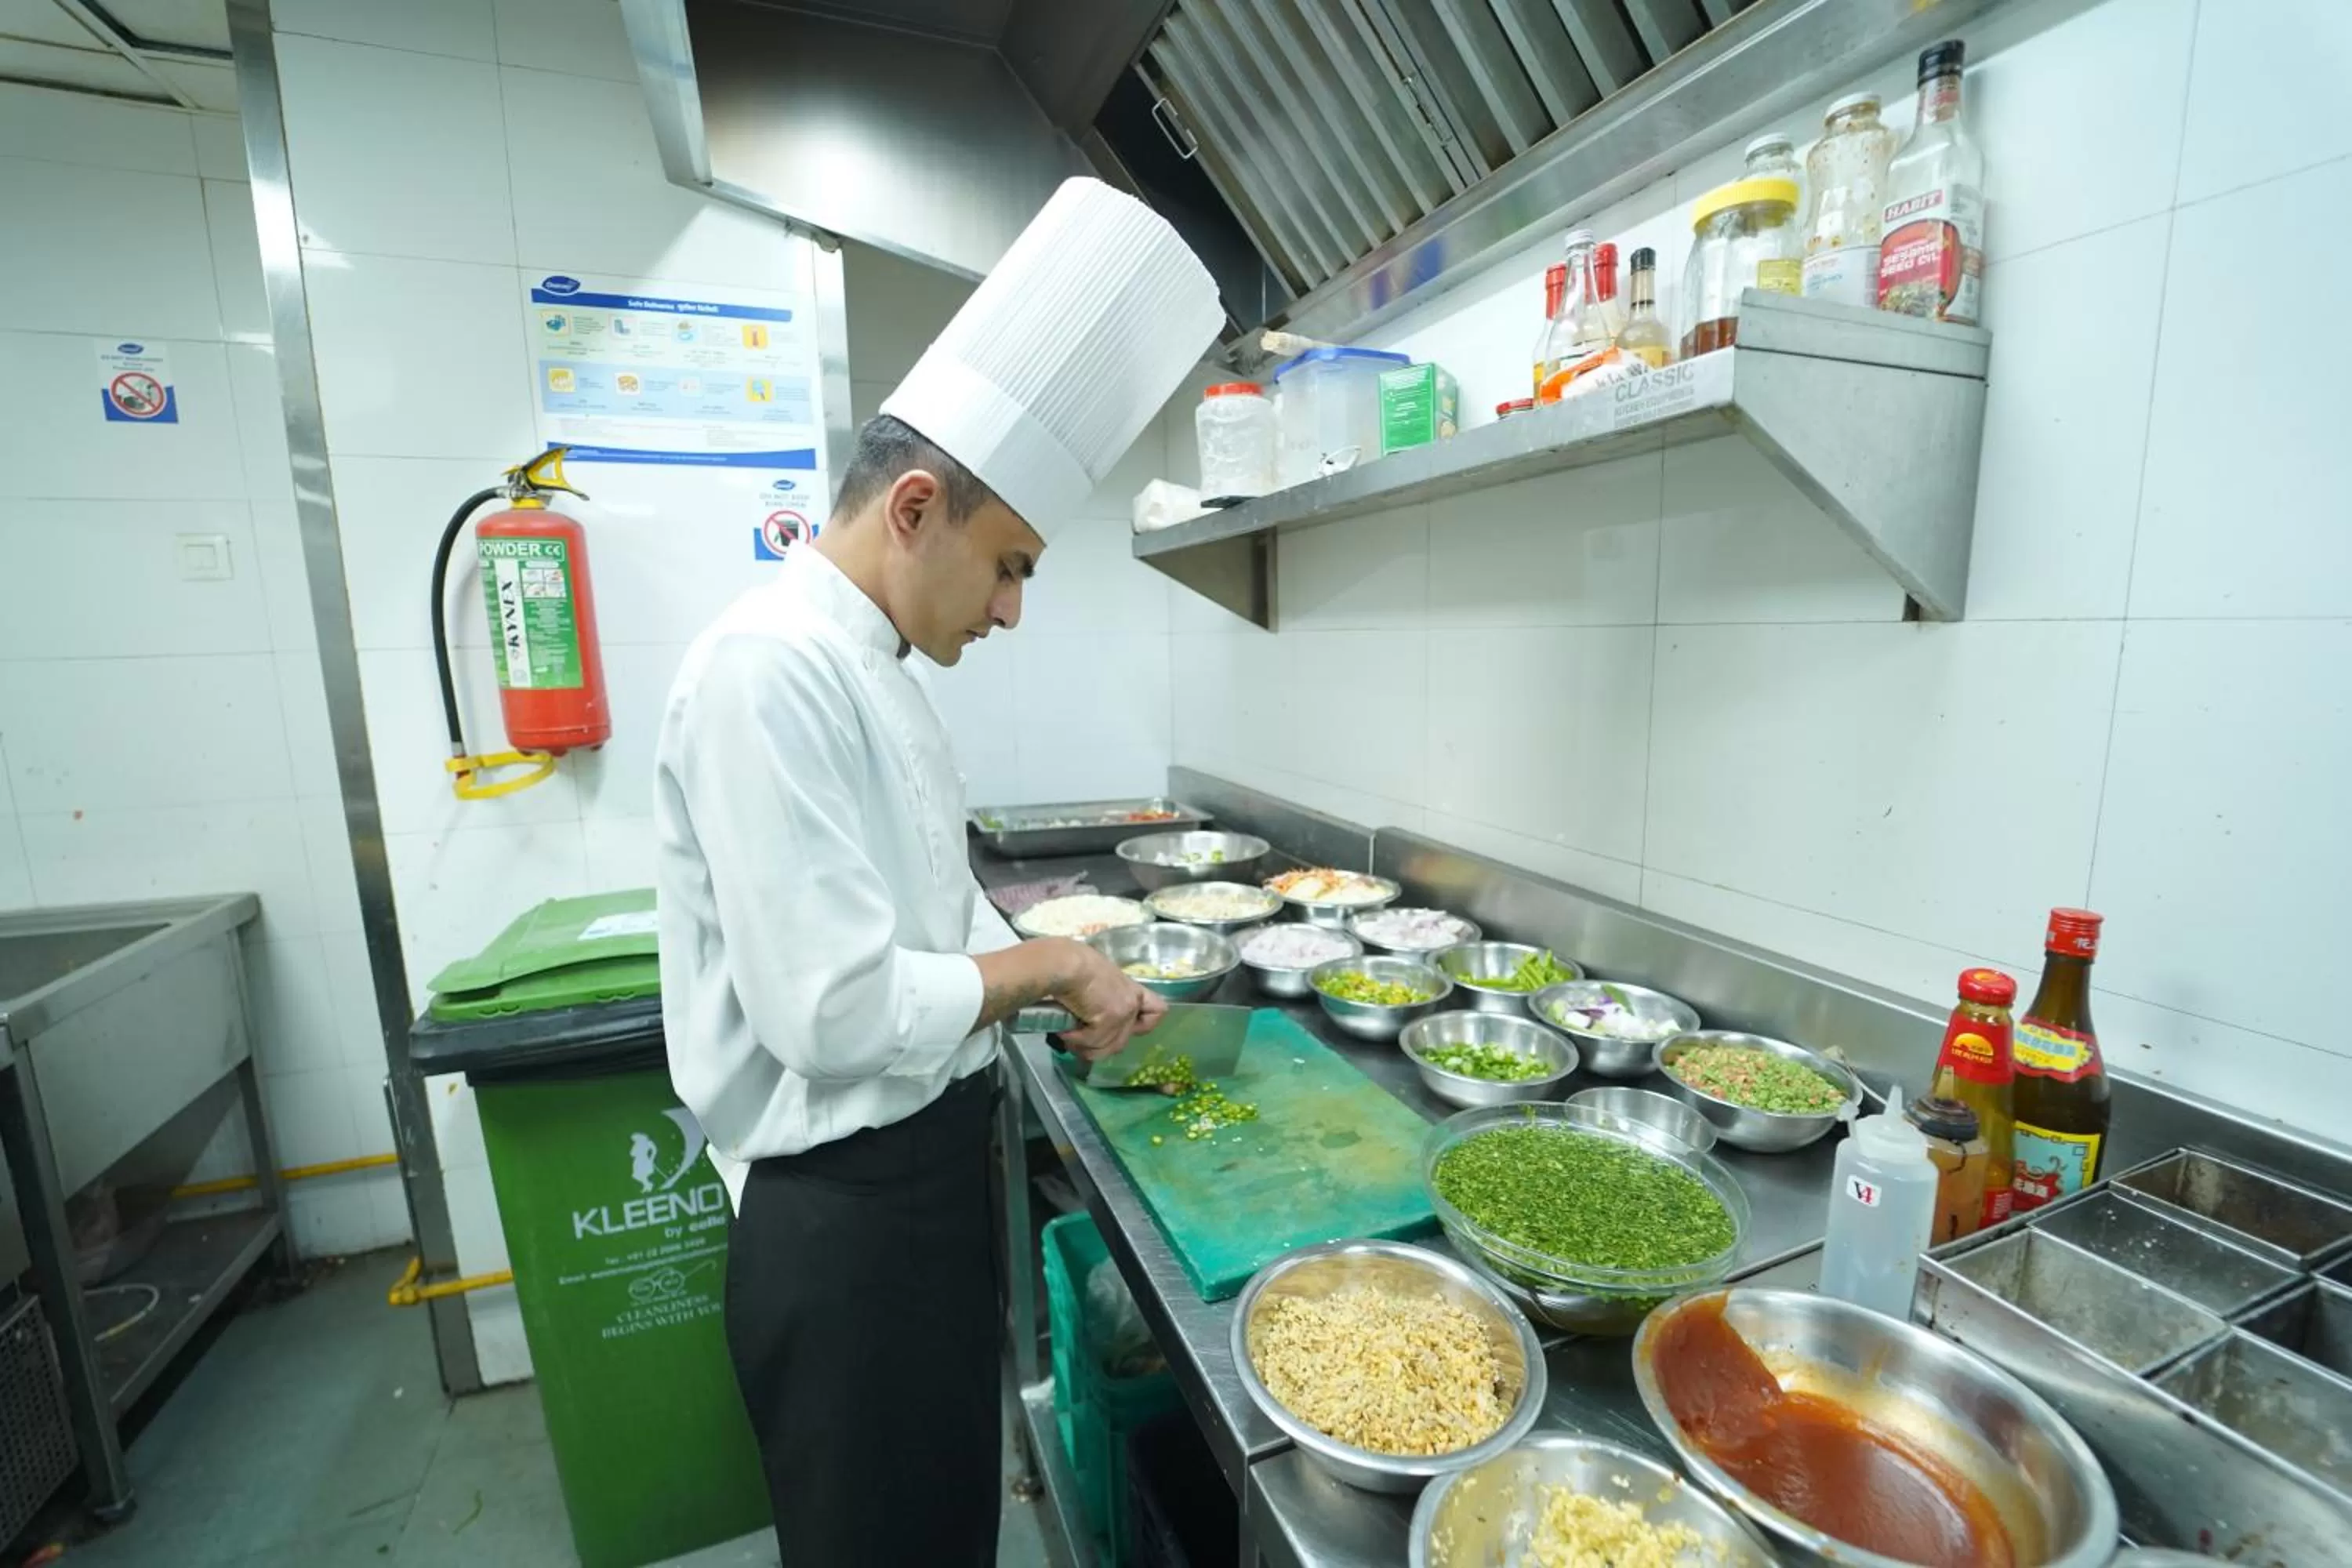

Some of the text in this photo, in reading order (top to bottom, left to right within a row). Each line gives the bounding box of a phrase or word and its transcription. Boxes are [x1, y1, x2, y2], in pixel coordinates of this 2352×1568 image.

[1886, 191, 1940, 220] HABIT
[1615, 362, 1694, 402] CLASSIC
[572, 1182, 724, 1240] KLEENO
[664, 1225, 683, 1239] by
